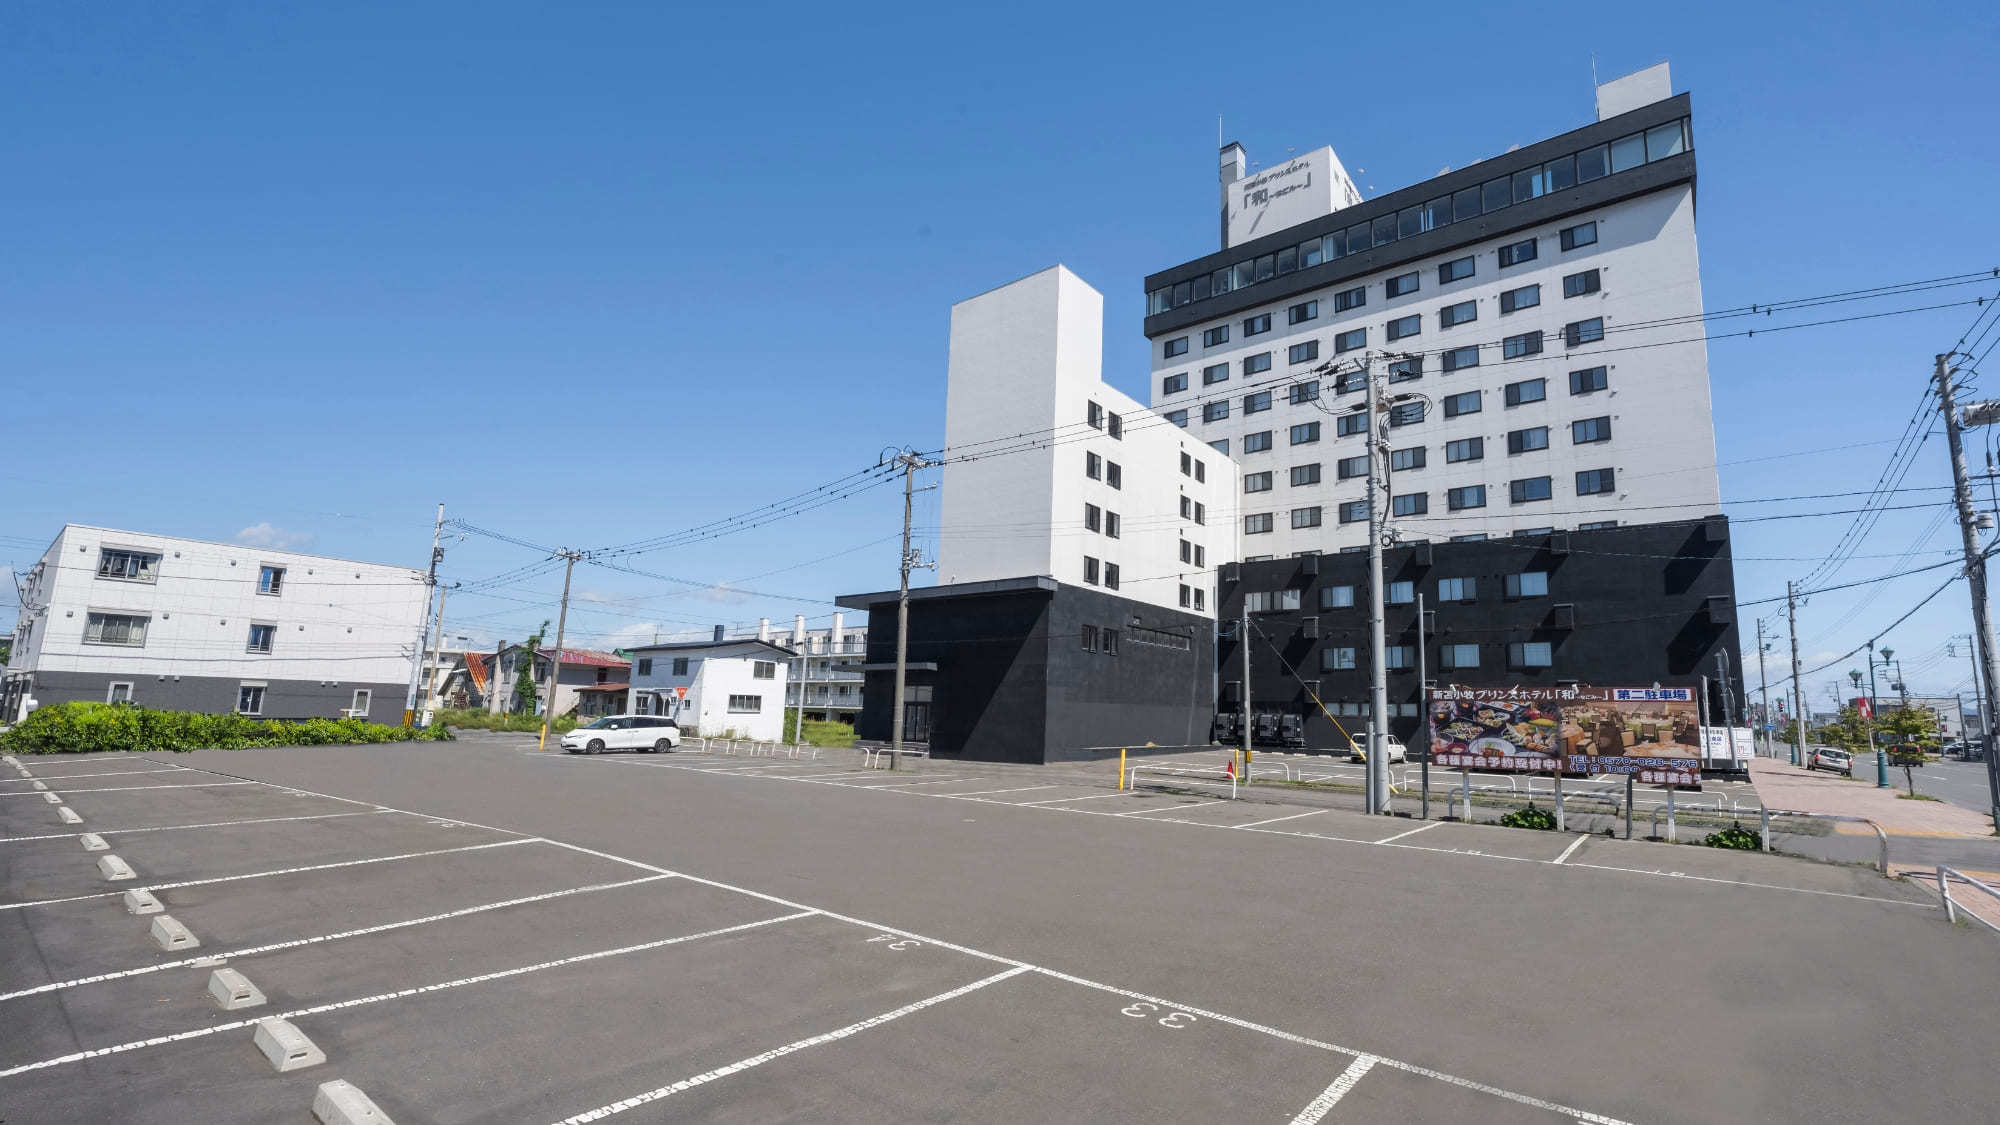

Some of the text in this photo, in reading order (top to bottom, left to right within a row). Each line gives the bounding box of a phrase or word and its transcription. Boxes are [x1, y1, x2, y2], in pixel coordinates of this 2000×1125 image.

[1617, 689, 1688, 701] 第二駐車場
[1121, 1002, 1197, 1029] 33
